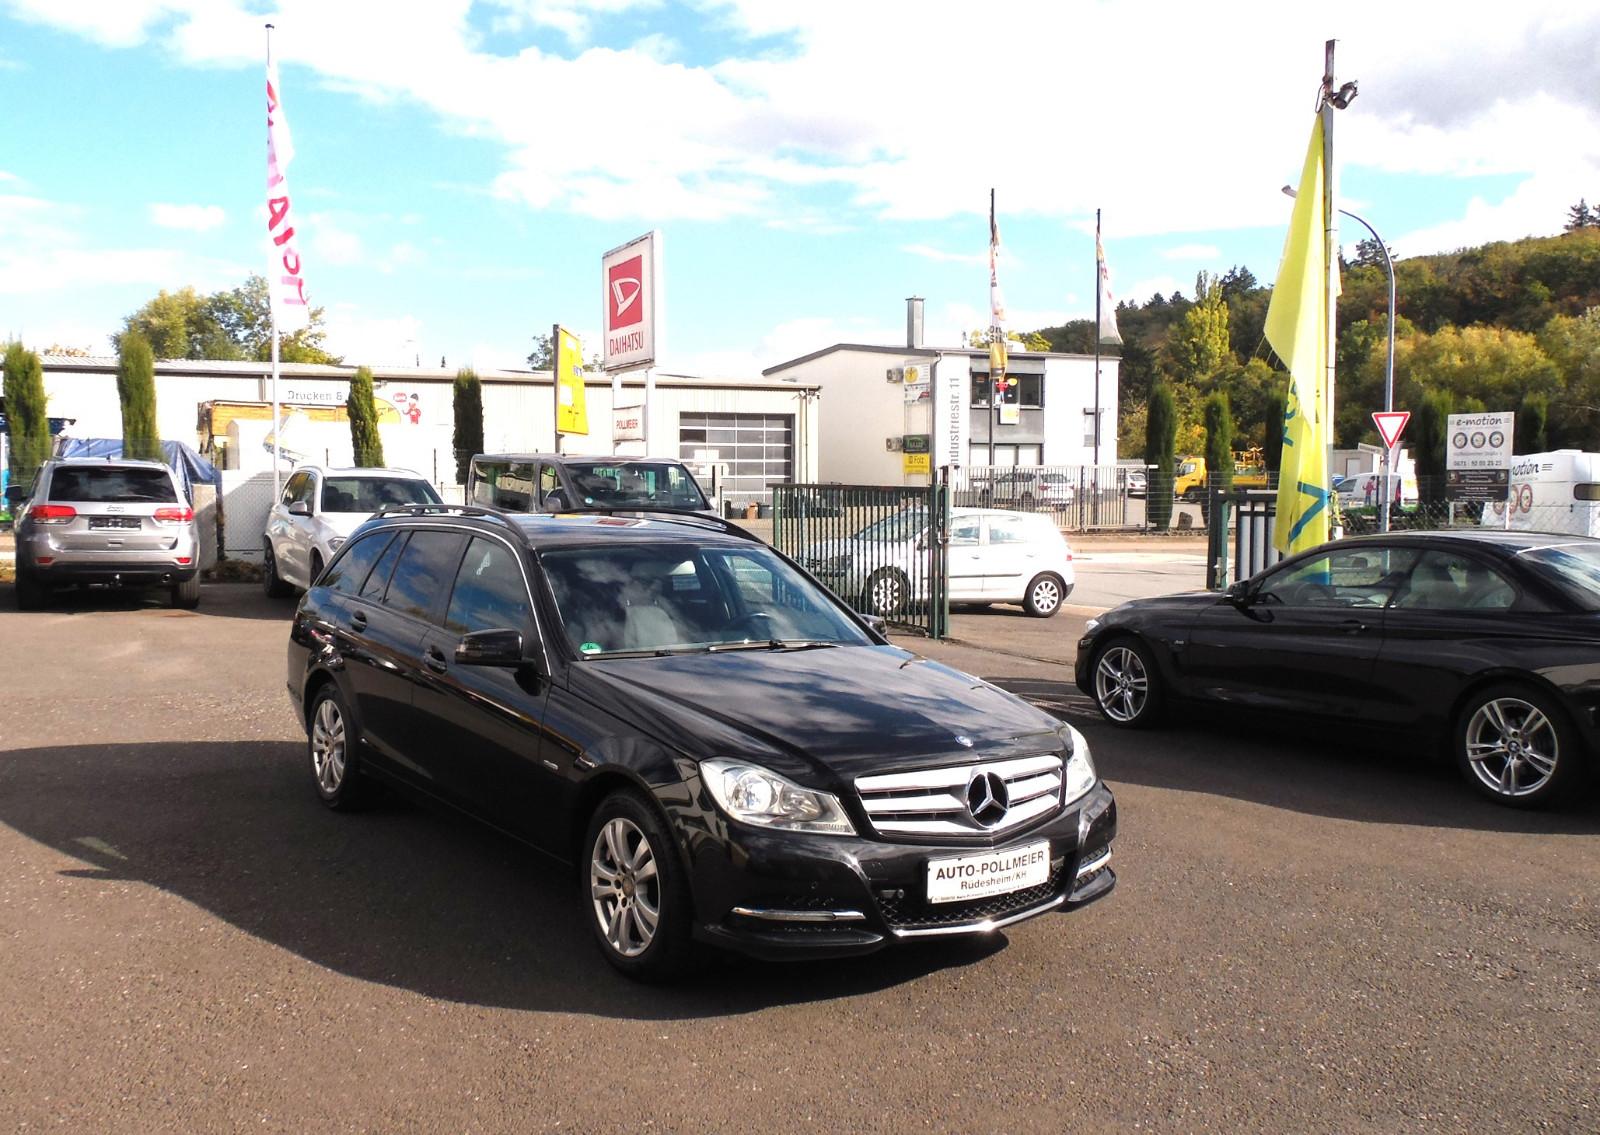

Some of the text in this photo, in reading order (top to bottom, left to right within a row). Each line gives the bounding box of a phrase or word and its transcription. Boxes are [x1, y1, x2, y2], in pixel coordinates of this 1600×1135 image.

[609, 330, 644, 356] DAIHATSU
[288, 391, 333, 401] Drucken
[949, 377, 960, 466] ndustriestr. 11
[1456, 415, 1502, 426] e-motion
[936, 850, 1044, 881] AUTO-POLLMEIER
[961, 871, 1027, 890] Rüdesheim/KH
